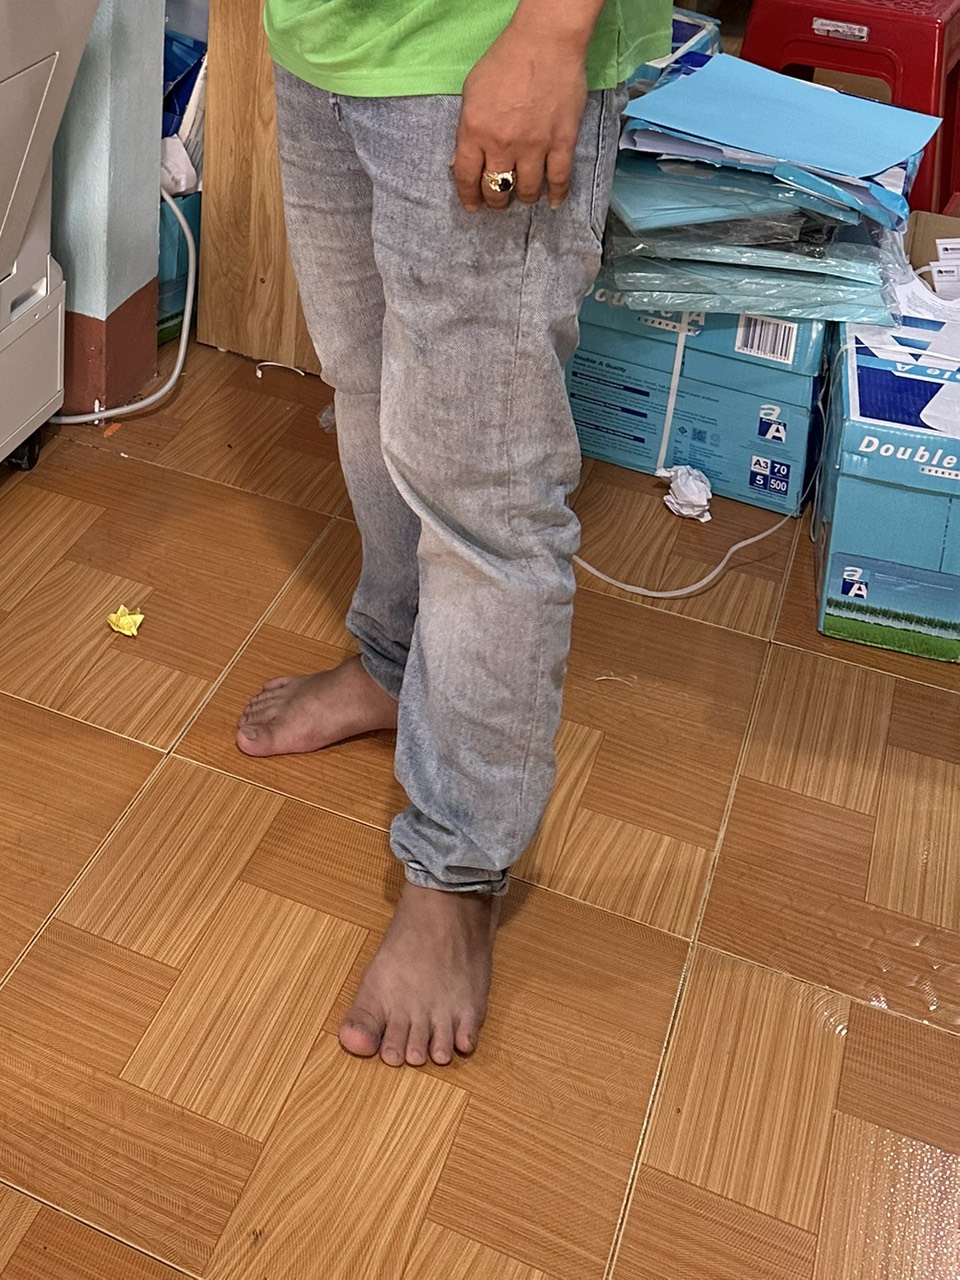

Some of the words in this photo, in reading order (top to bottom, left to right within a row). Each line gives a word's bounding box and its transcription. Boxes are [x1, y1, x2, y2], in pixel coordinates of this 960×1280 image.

[858, 436, 958, 468] Double
[754, 459, 769, 470] A3
[773, 464, 788, 475] 70
[756, 475, 764, 485] 5
[770, 479, 787, 491] 500
